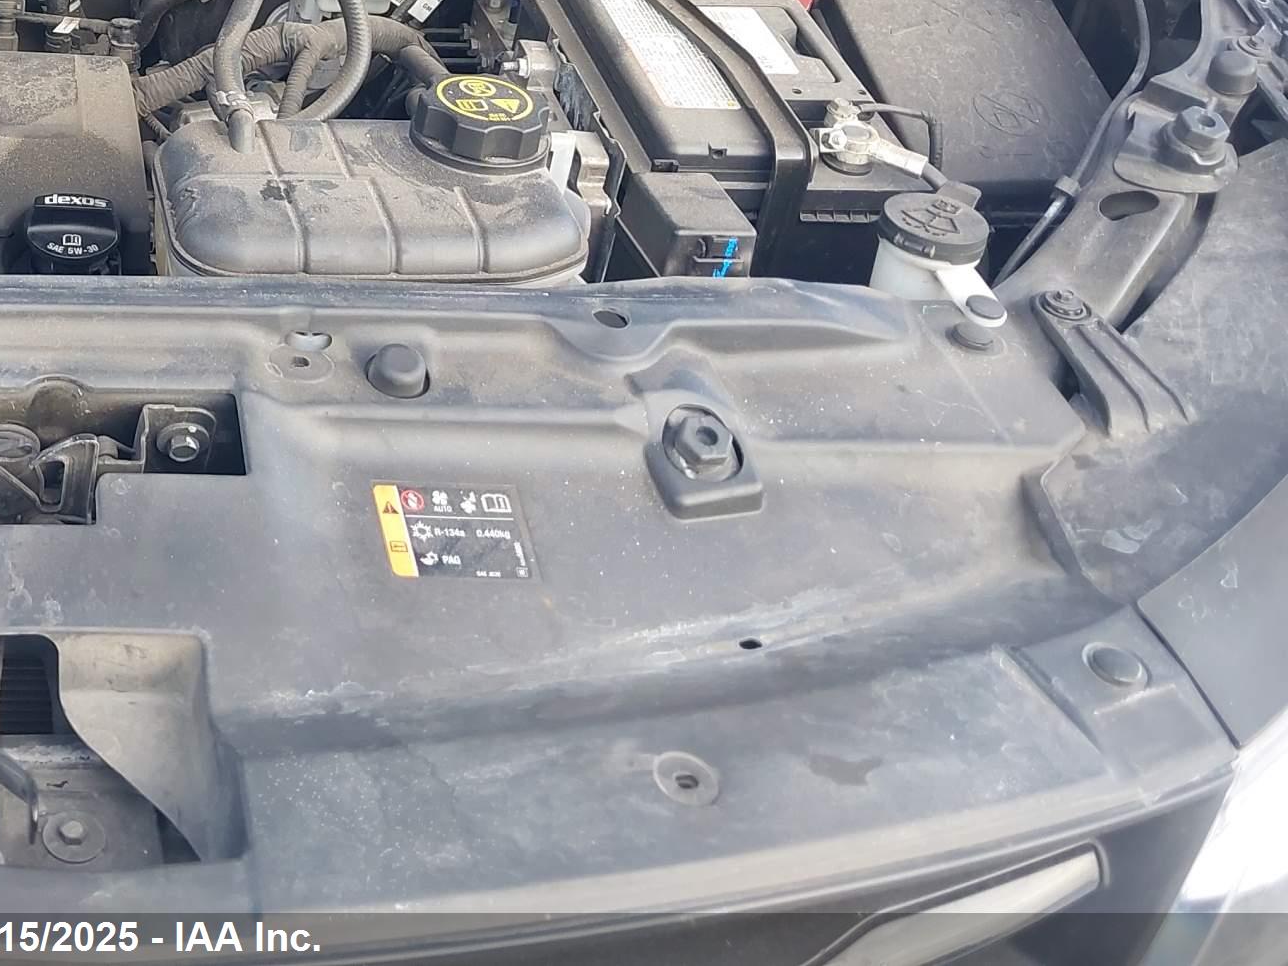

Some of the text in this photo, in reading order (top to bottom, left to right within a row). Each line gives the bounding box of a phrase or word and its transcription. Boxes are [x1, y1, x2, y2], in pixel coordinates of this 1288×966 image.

[44, 194, 107, 207] dexos
[47, 242, 99, 255] SAE 5W-30
[434, 527, 511, 540] R-134a 0.440kg
